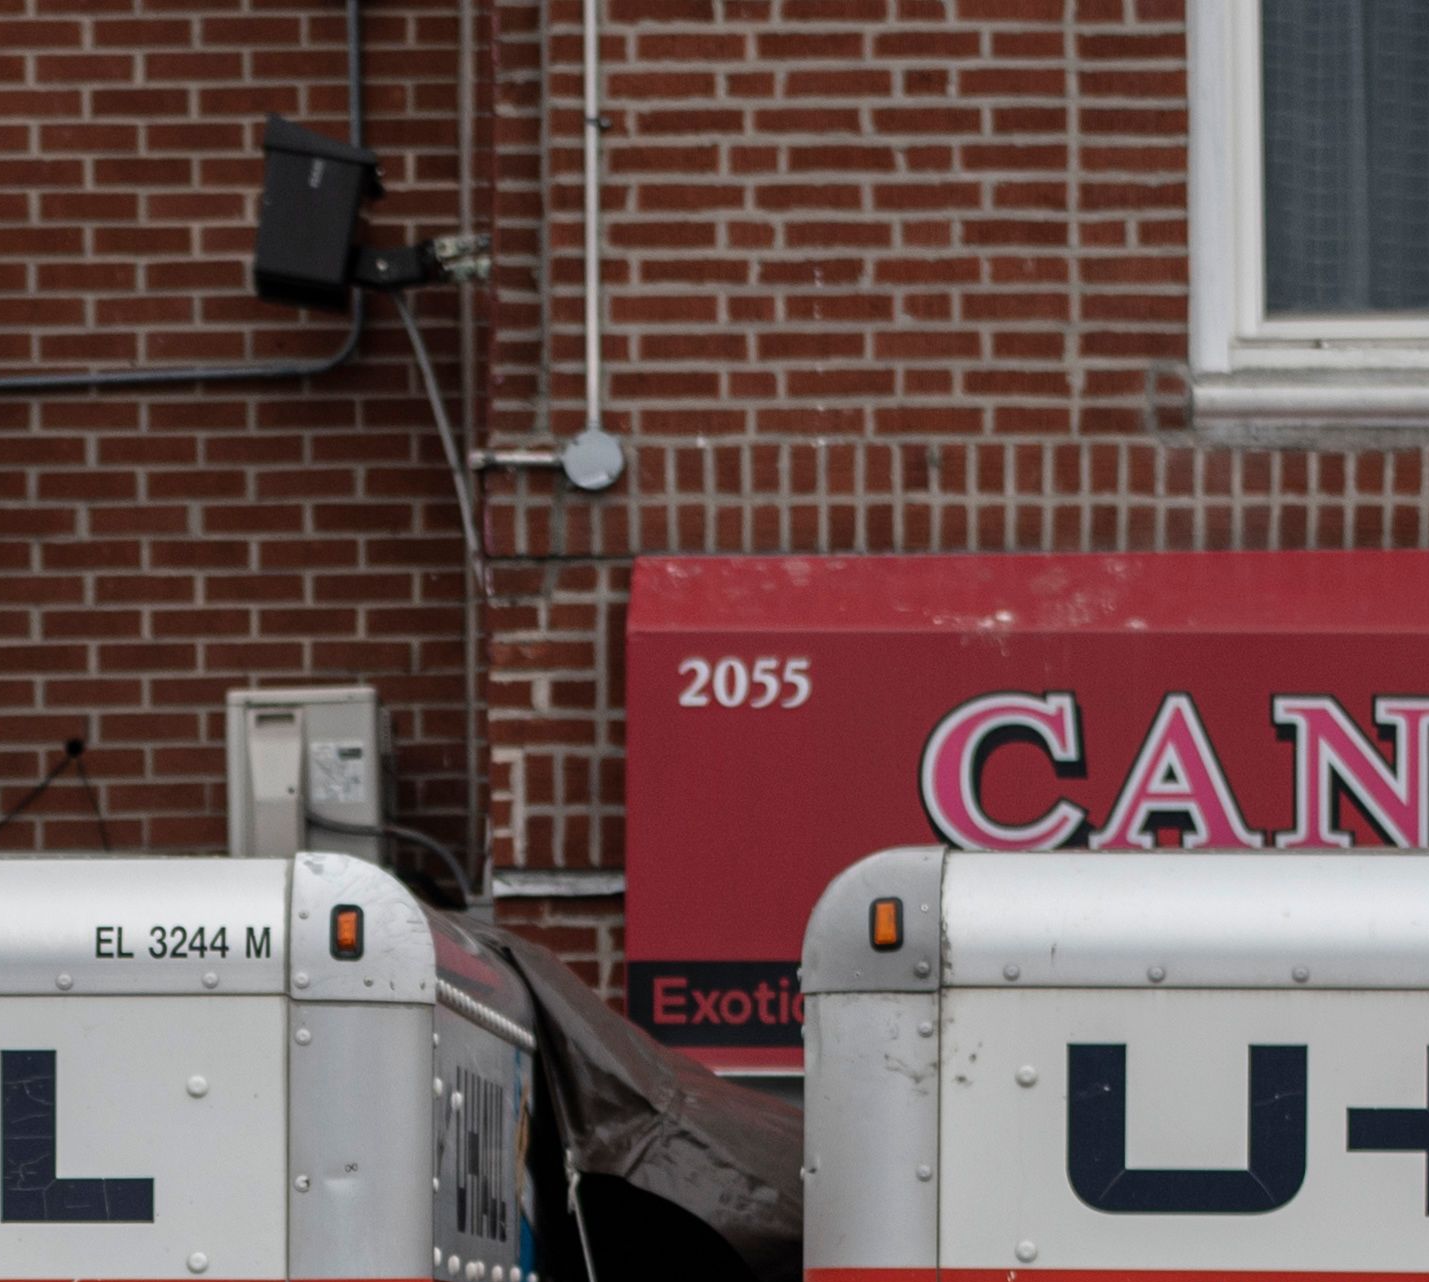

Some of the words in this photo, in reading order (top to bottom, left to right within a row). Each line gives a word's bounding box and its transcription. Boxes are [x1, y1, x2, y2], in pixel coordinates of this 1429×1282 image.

[678, 656, 812, 709] 2055
[95, 926, 135, 960] EL
[148, 925, 230, 960] 3244
[245, 926, 271, 960] M
